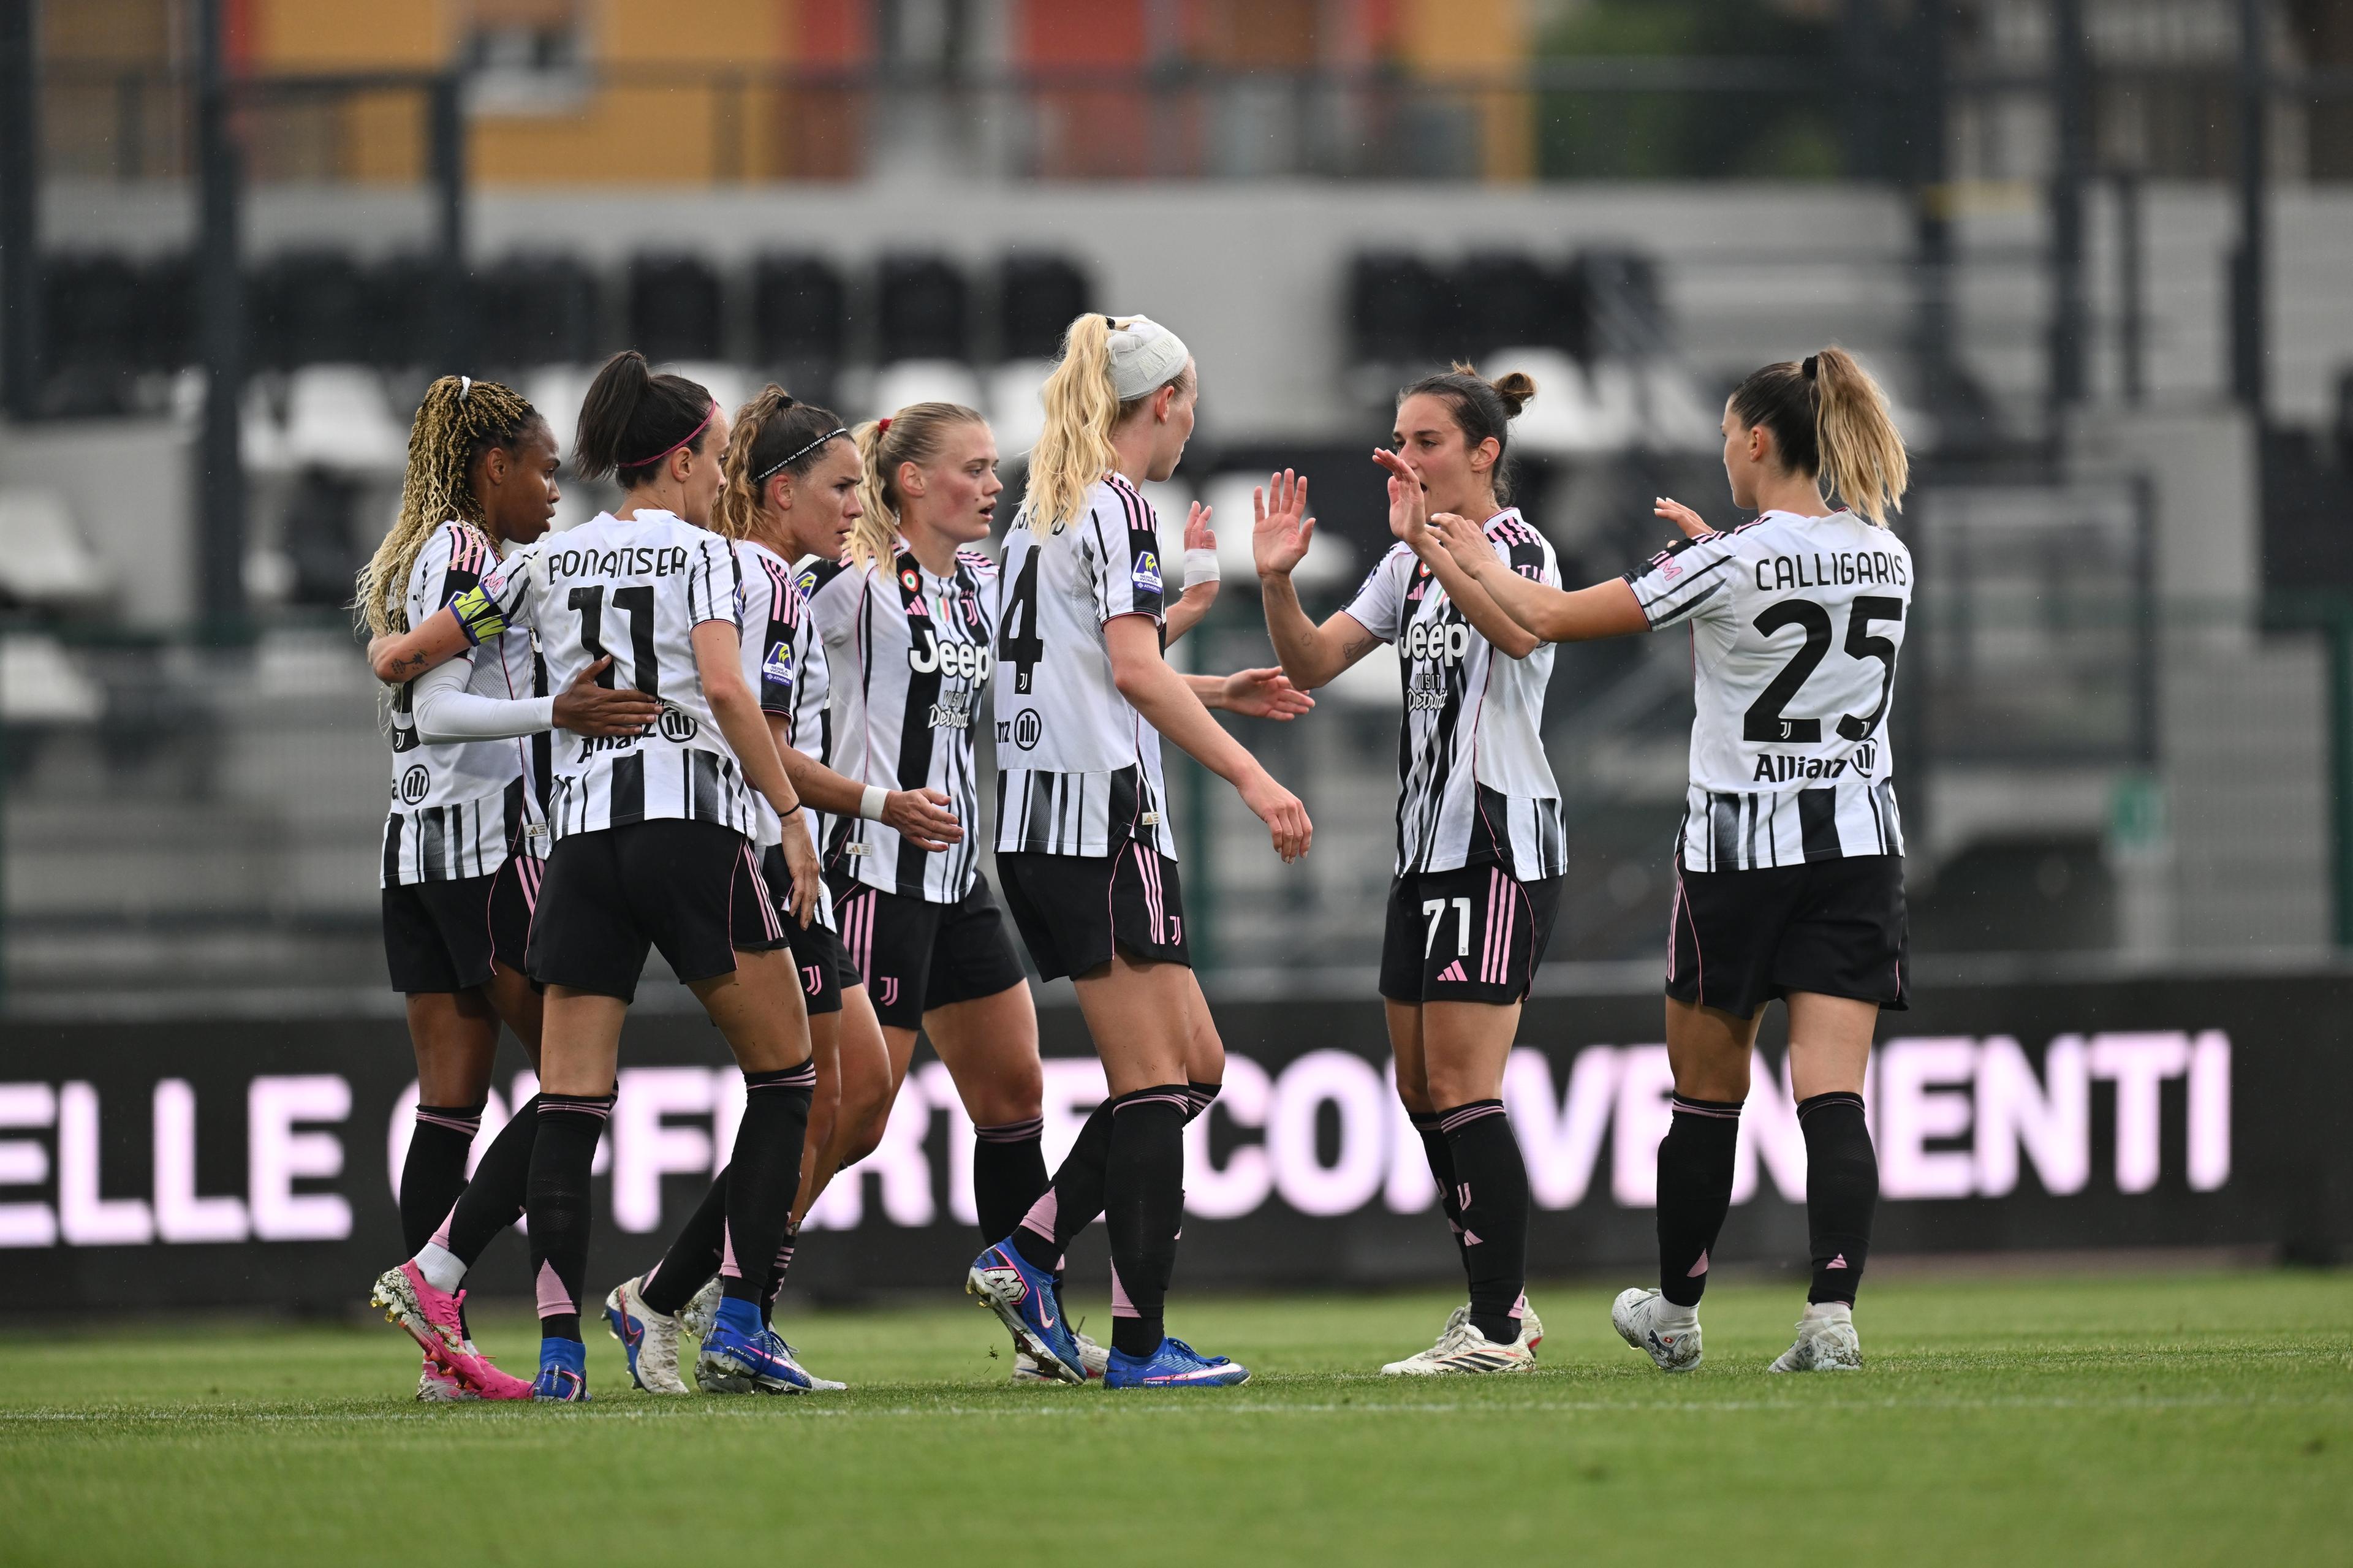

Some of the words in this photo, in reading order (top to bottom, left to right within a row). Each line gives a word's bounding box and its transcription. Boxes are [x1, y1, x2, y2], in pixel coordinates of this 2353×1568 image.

[796, 446, 809, 456] THREE
[809, 437, 825, 448] STRIPES
[548, 546, 688, 586] BONANSEA
[1756, 551, 1906, 591] CALLIGARIS
[568, 585, 659, 702] 11
[909, 630, 991, 688] Jeep
[1400, 614, 1469, 667] Jeep
[773, 676, 790, 684] ATHORA
[1415, 673, 1441, 690] VISIT
[1743, 596, 1903, 743] 25
[928, 703, 970, 729] Detroit
[944, 690, 968, 708] VISIT
[1407, 687, 1448, 713] Detroit
[1423, 898, 1471, 960] 71
